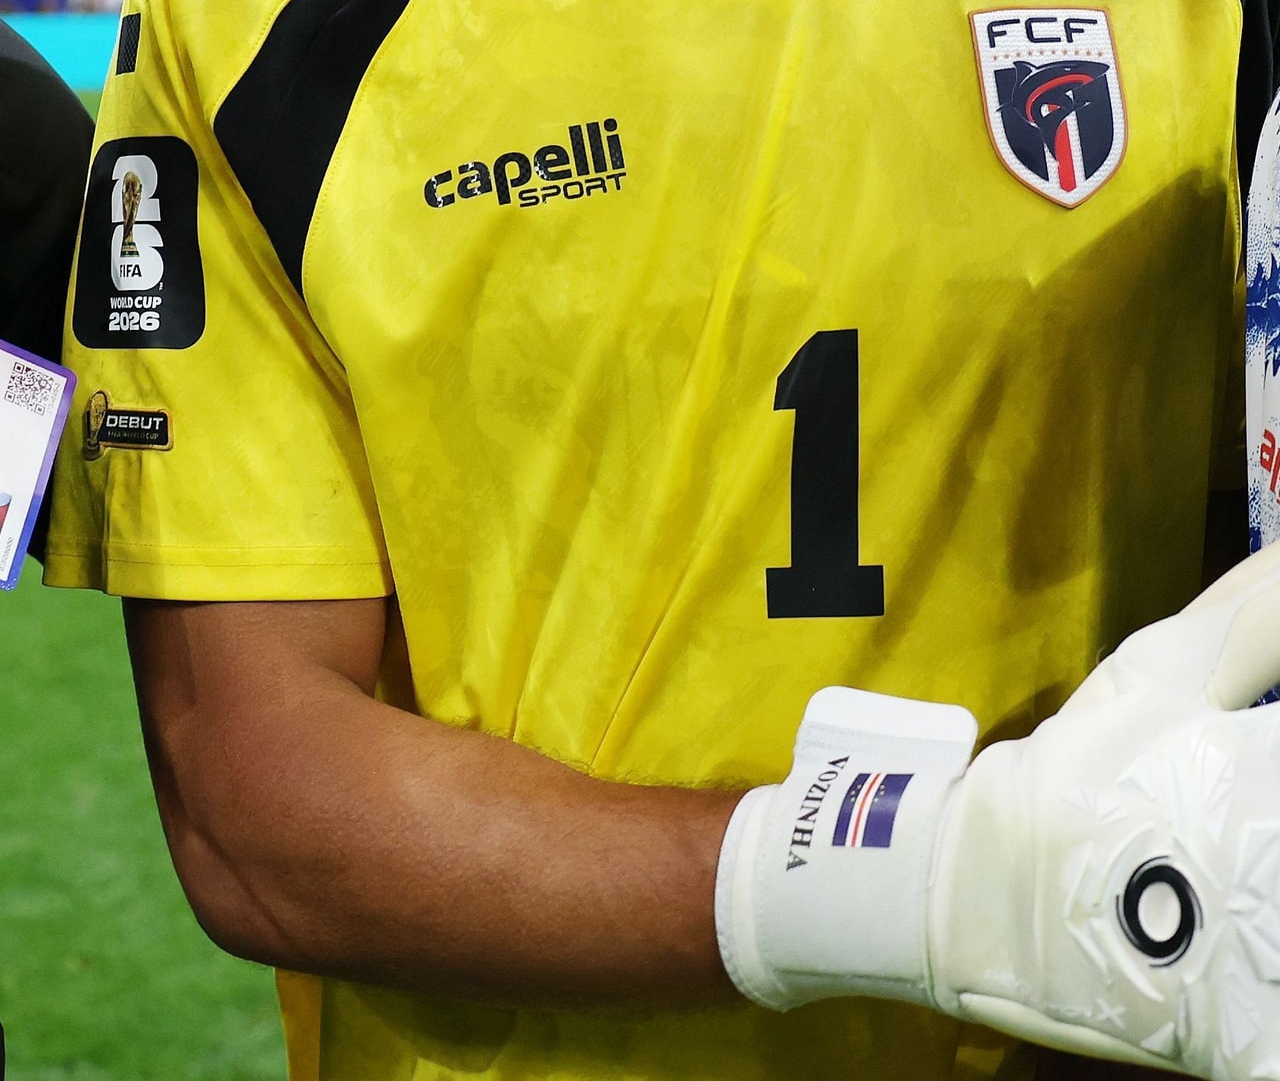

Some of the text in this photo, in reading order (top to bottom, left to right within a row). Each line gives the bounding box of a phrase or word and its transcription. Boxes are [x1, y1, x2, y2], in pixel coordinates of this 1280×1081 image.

[987, 17, 1098, 48] FCF
[424, 118, 625, 208] capelli
[519, 172, 627, 207] SPORT
[119, 264, 142, 277] FIFA
[110, 296, 162, 309] WORLD CUP
[109, 312, 160, 331] 2026
[106, 415, 163, 430] DEBUT
[766, 328, 884, 618] 1
[786, 755, 850, 872] VOZINHA
